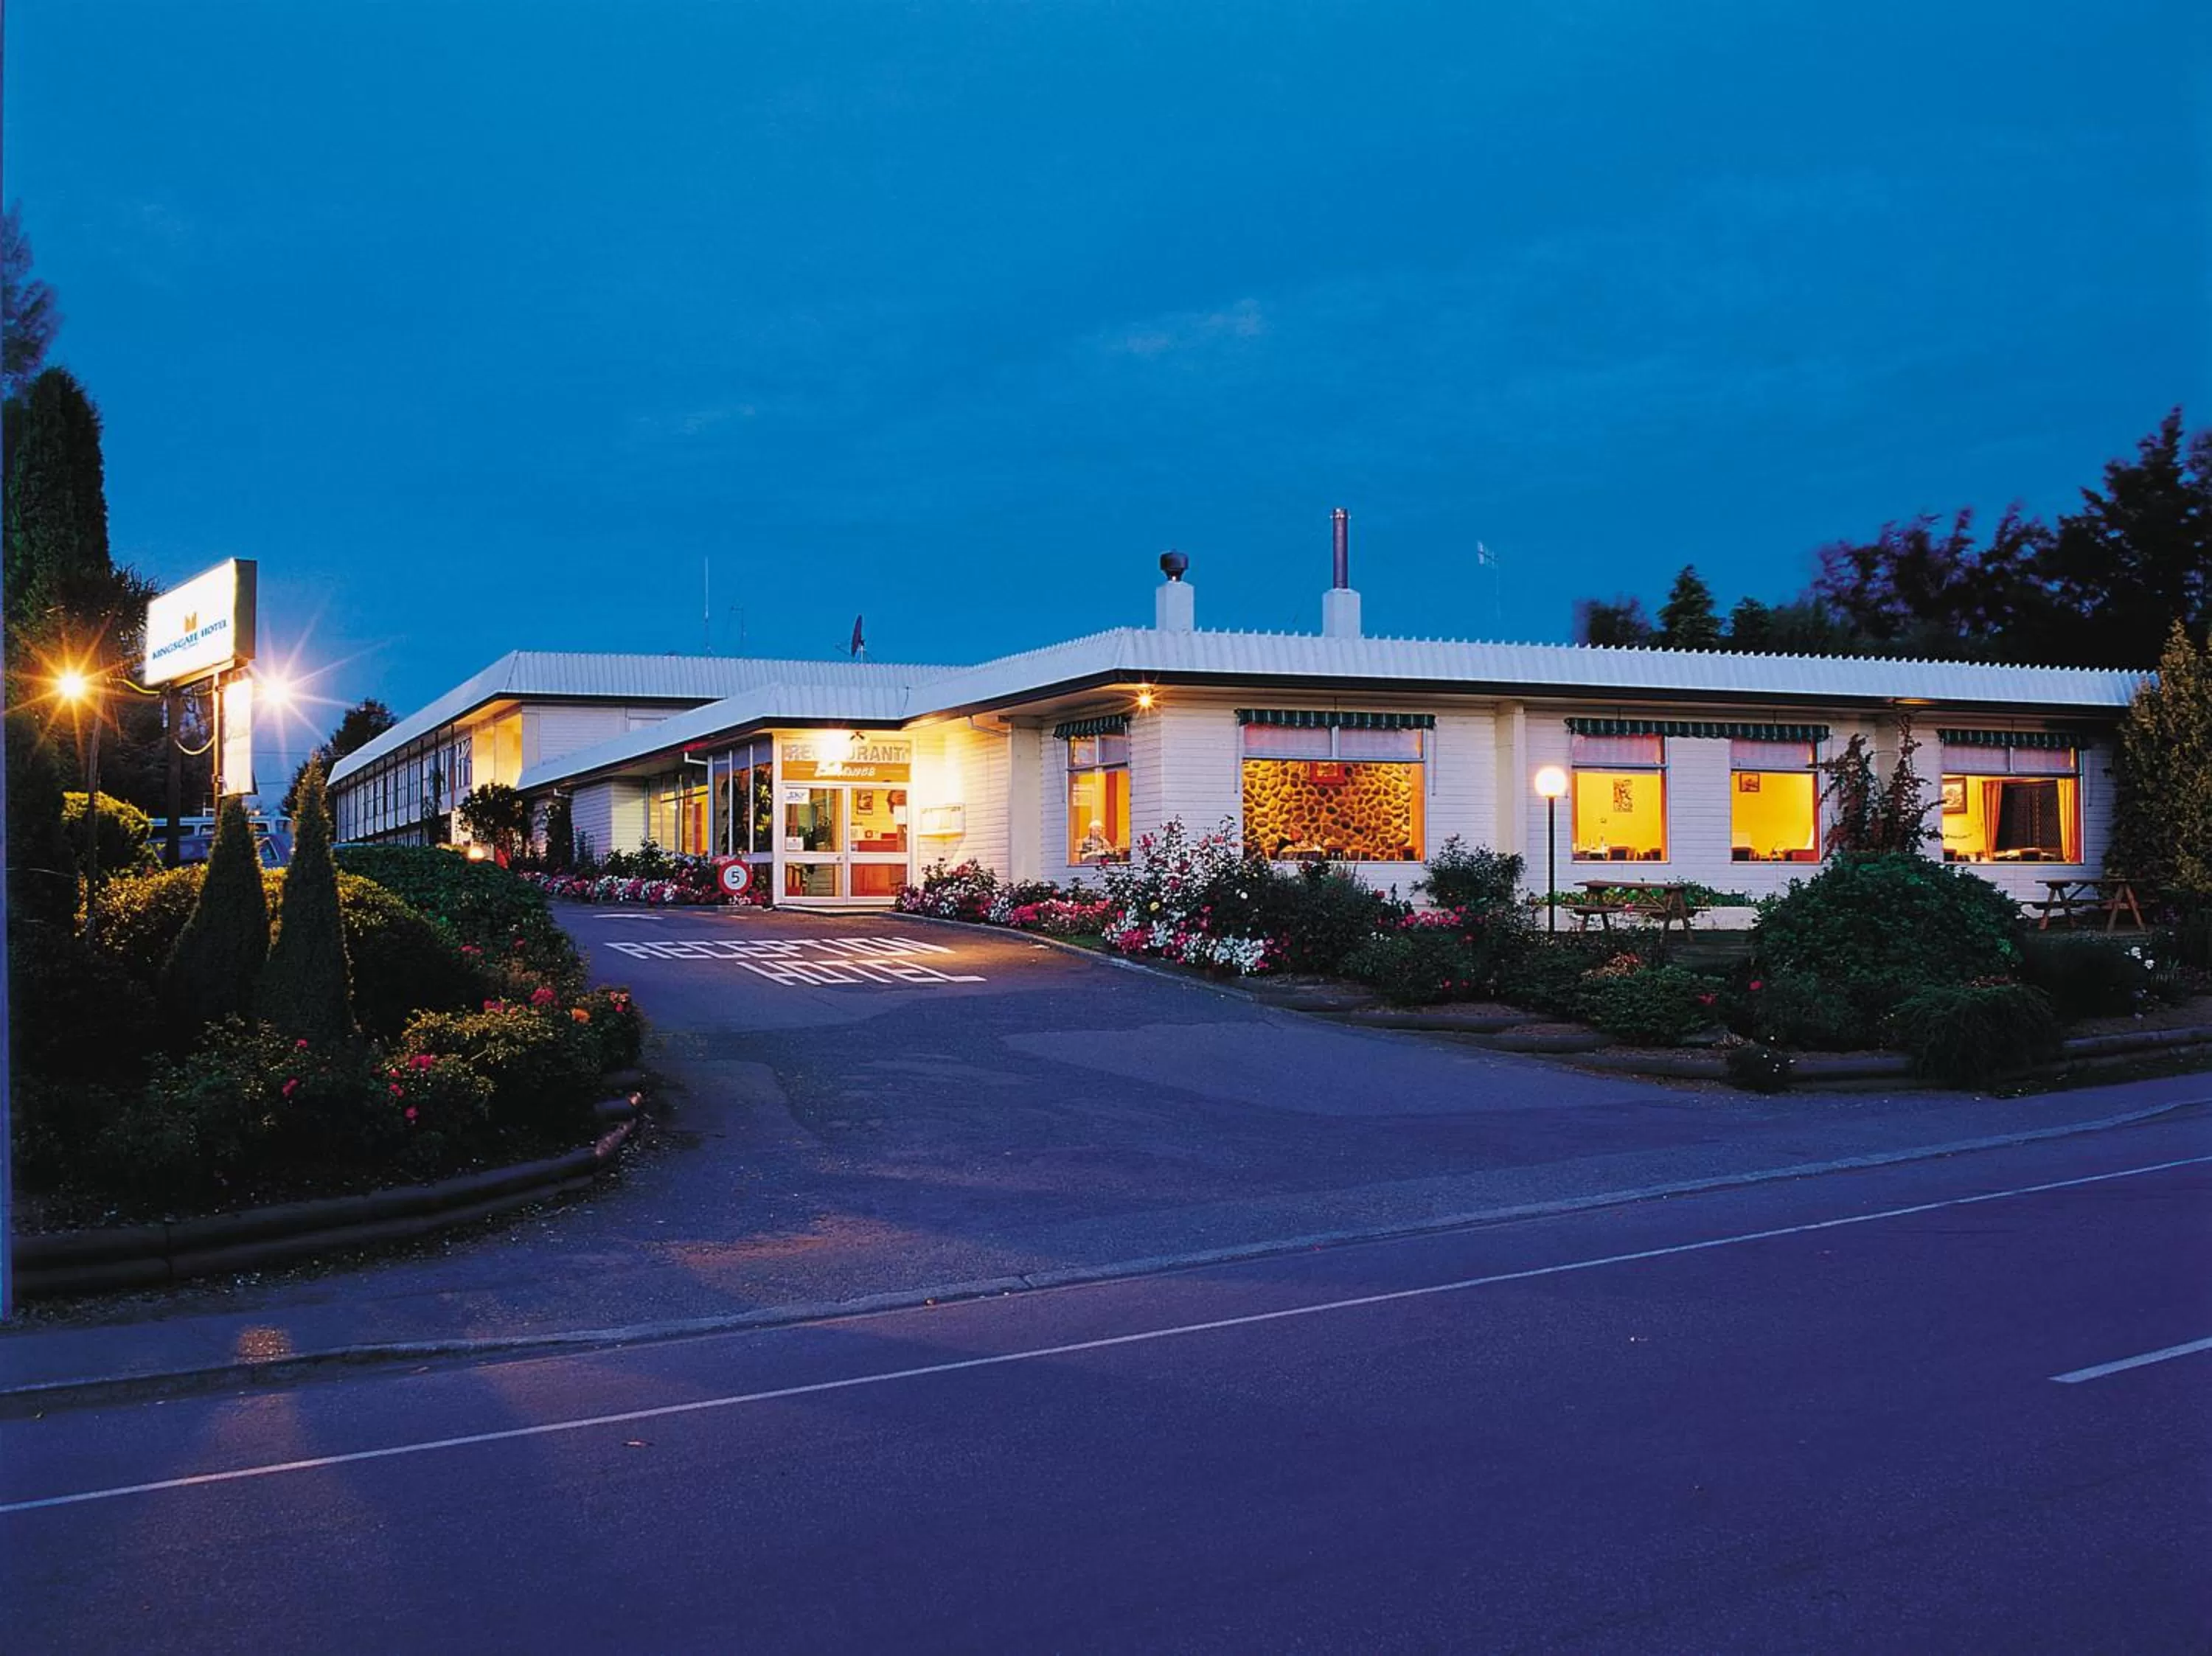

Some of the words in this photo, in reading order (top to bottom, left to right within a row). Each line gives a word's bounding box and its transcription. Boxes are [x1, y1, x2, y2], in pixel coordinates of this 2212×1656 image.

[201, 619, 227, 637] HOTEL
[731, 871, 740, 884] 5
[605, 936, 957, 959] RECEPTION
[737, 959, 987, 987] HOTEL
